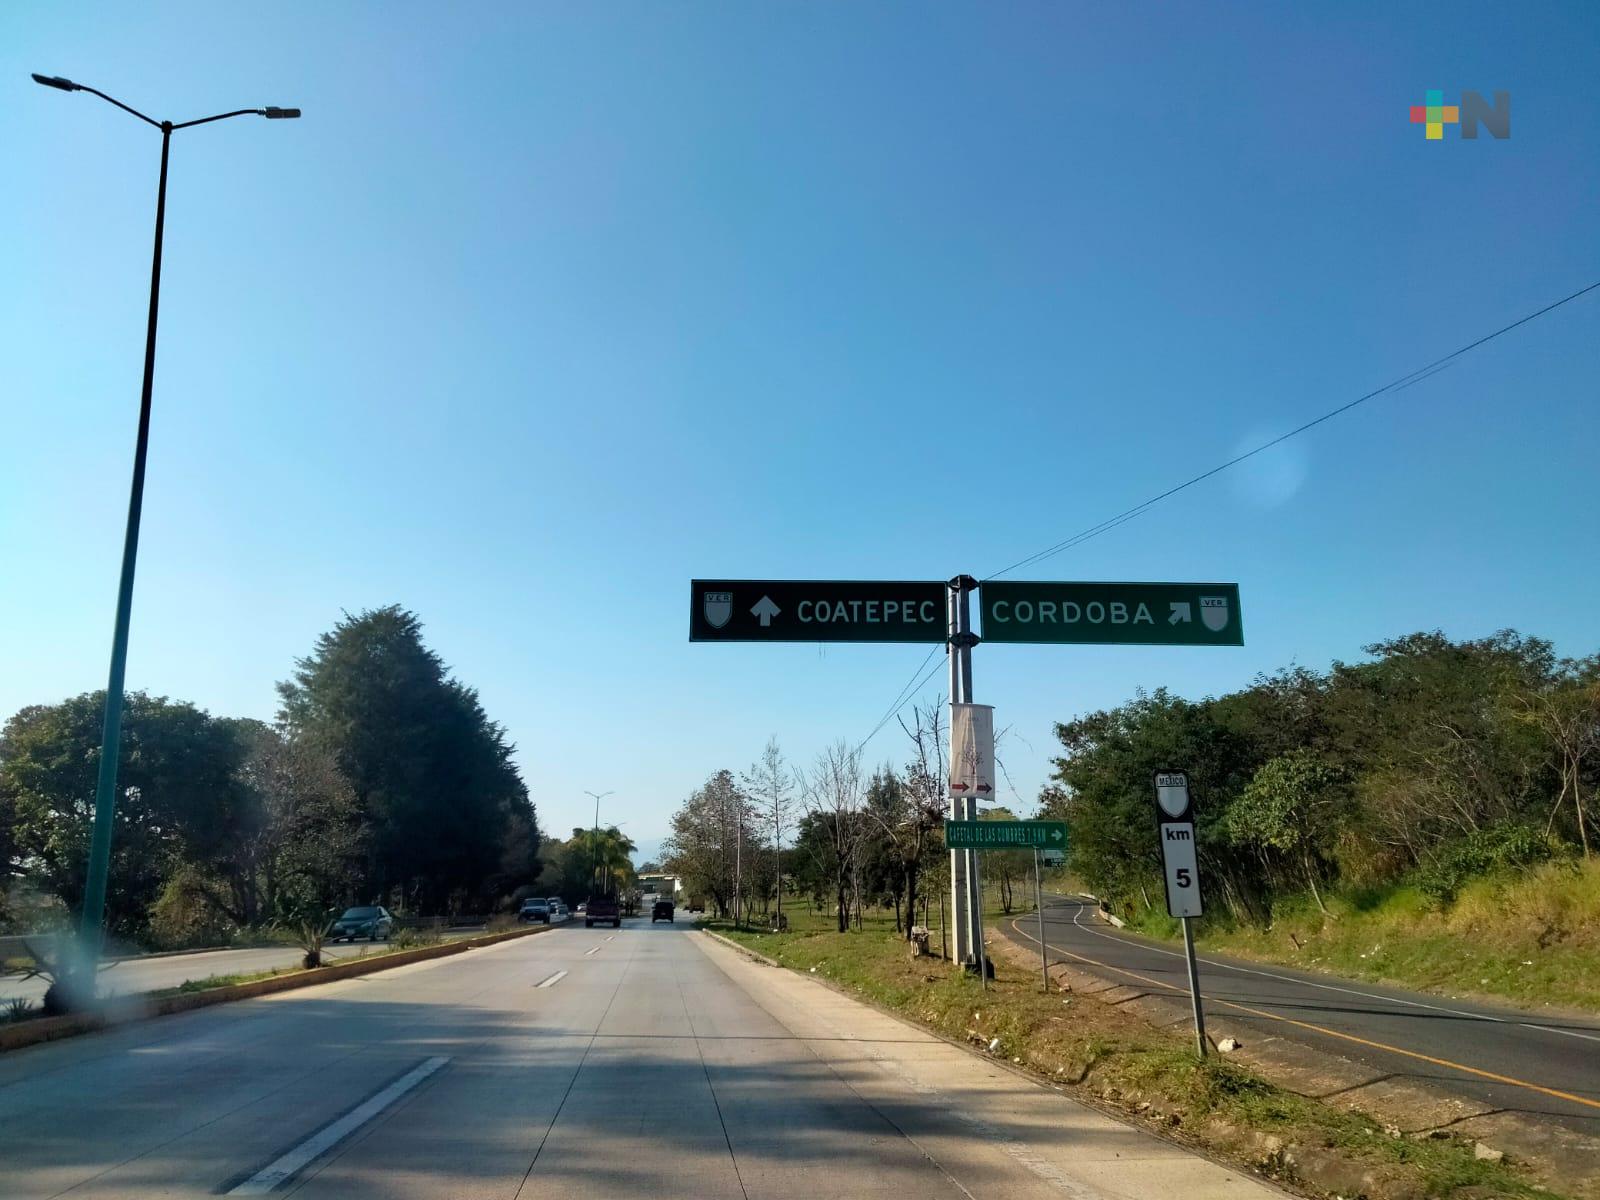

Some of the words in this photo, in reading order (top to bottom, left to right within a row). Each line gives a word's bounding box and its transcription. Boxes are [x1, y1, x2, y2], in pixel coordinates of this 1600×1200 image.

[797, 600, 935, 623] COATEPEC
[992, 600, 1155, 625] CORDOBA
[949, 827, 974, 842] CAFETAL
[975, 827, 983, 842] DE
[984, 827, 996, 842] LAS
[1165, 827, 1190, 841] km
[1176, 868, 1191, 888] 5
